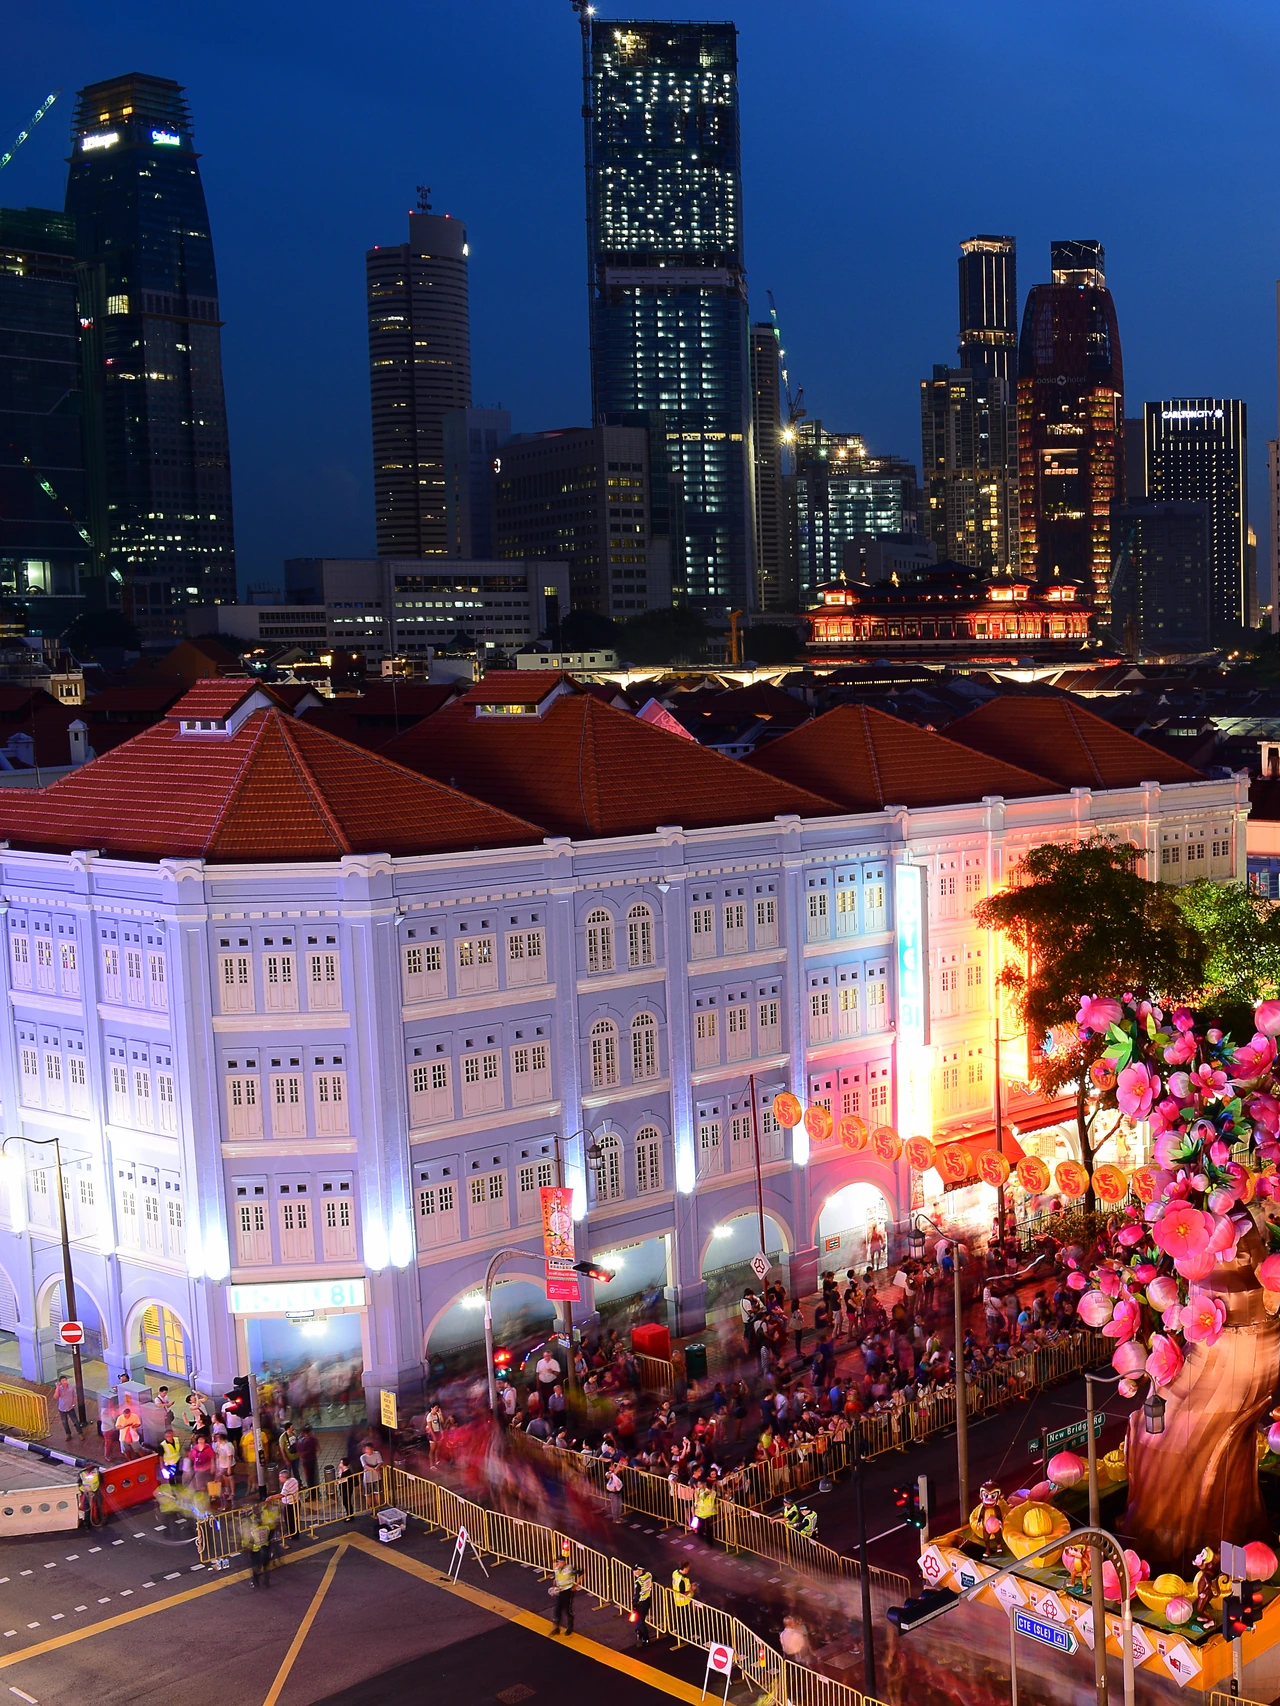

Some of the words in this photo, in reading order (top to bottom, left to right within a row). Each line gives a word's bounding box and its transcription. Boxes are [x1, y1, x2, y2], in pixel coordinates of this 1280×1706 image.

[1162, 410, 1196, 418] CARLTON
[1197, 410, 1213, 418] CITY
[330, 1284, 355, 1306] 81
[1049, 1431, 1065, 1442] New
[1067, 1421, 1089, 1436] Bridg
[1093, 1415, 1102, 1425] Rd
[1018, 1618, 1031, 1631] CTE
[1033, 1623, 1051, 1640] (SLE)
